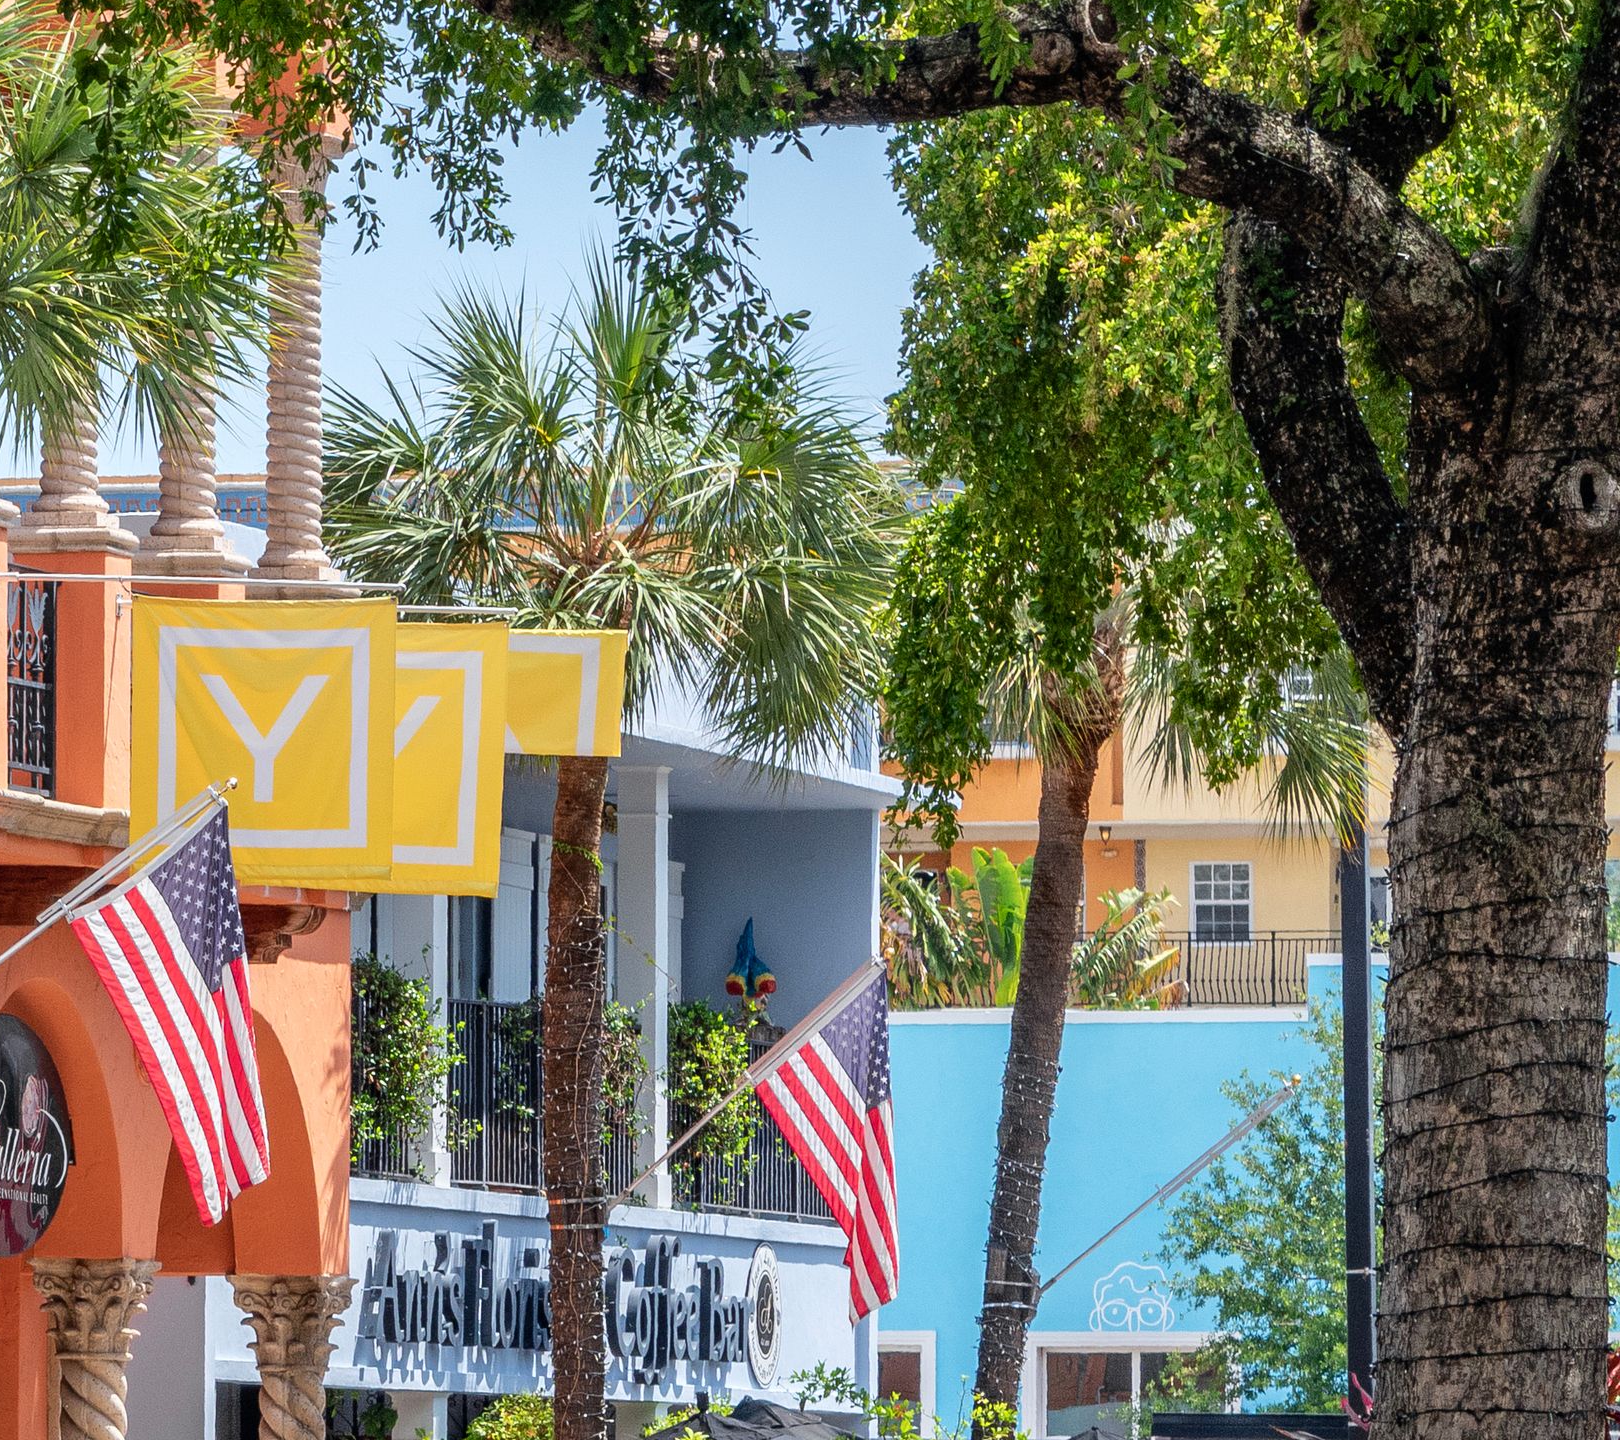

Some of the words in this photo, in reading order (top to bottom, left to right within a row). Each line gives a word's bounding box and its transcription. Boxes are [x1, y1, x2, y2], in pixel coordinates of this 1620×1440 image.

[199, 674, 330, 803] Y
[605, 1234, 701, 1386] Coffee
[696, 1258, 755, 1363] Bar
